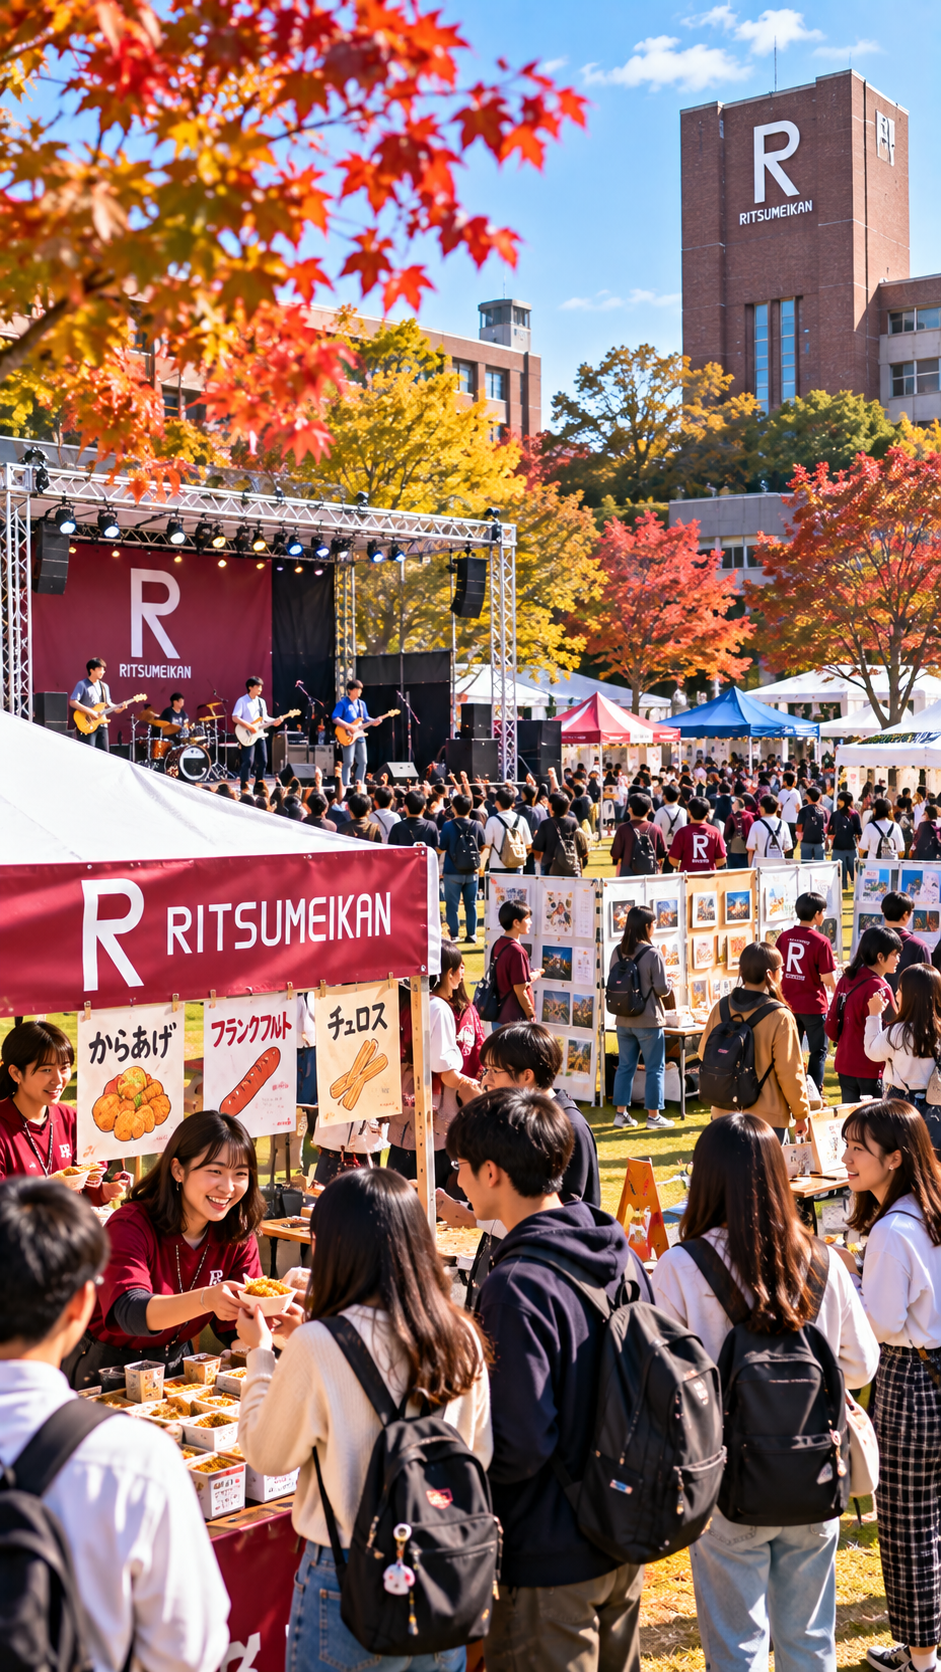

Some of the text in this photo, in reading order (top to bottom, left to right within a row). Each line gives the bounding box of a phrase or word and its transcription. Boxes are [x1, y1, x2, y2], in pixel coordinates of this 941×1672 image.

[753, 120, 800, 204] R
[739, 199, 813, 226] RITSUMEIKAN
[130, 567, 181, 659] R
[119, 663, 192, 679] RITSUMEIKAN
[692, 834, 709, 859] R
[81, 878, 392, 992] R RITSUMEIKAN
[786, 941, 805, 974] R
[210, 1011, 293, 1049] フランクフルト
[327, 1002, 389, 1042] チュロス
[88, 1021, 177, 1066] からあげ
